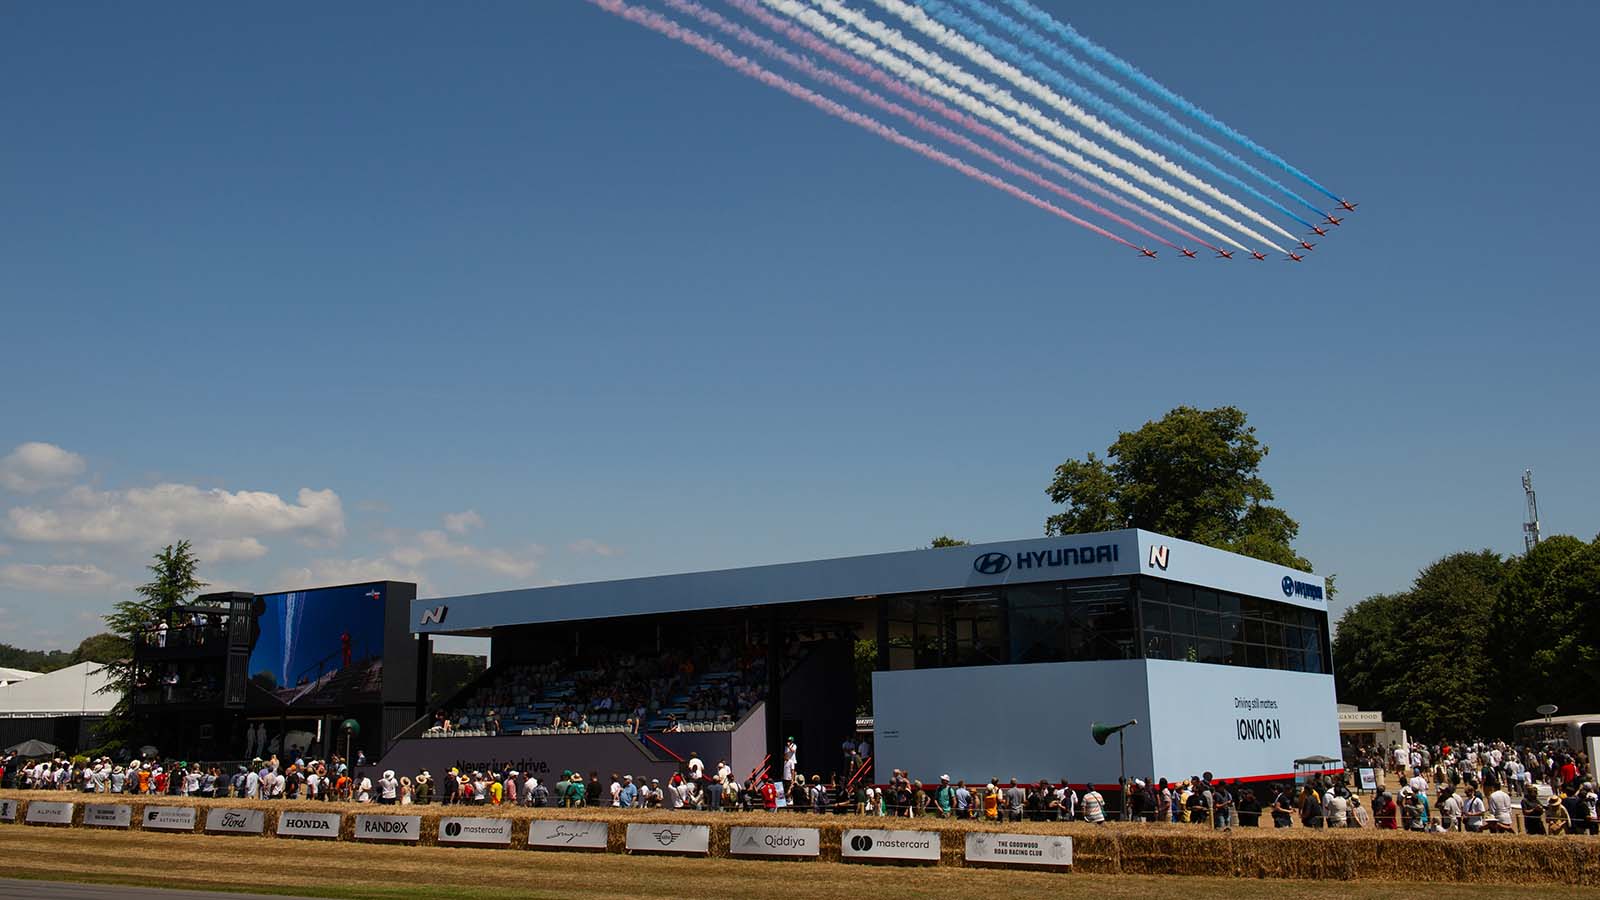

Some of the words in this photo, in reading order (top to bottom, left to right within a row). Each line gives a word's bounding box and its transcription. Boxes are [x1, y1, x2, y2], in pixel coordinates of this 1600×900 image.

[1017, 544, 1118, 570] HYUNDAI
[1236, 719, 1265, 743] IONIQ
[1266, 719, 1272, 740] 6
[1272, 719, 1281, 740] N
[517, 758, 551, 773] drive.
[221, 812, 248, 828] Ford
[286, 819, 330, 830] HONDA
[365, 821, 408, 834] RANDOX
[463, 825, 504, 834] mastercard
[764, 834, 805, 849] Qiddiya
[876, 838, 930, 849] mastercard
[1009, 841, 1039, 849] GOODWOOD
